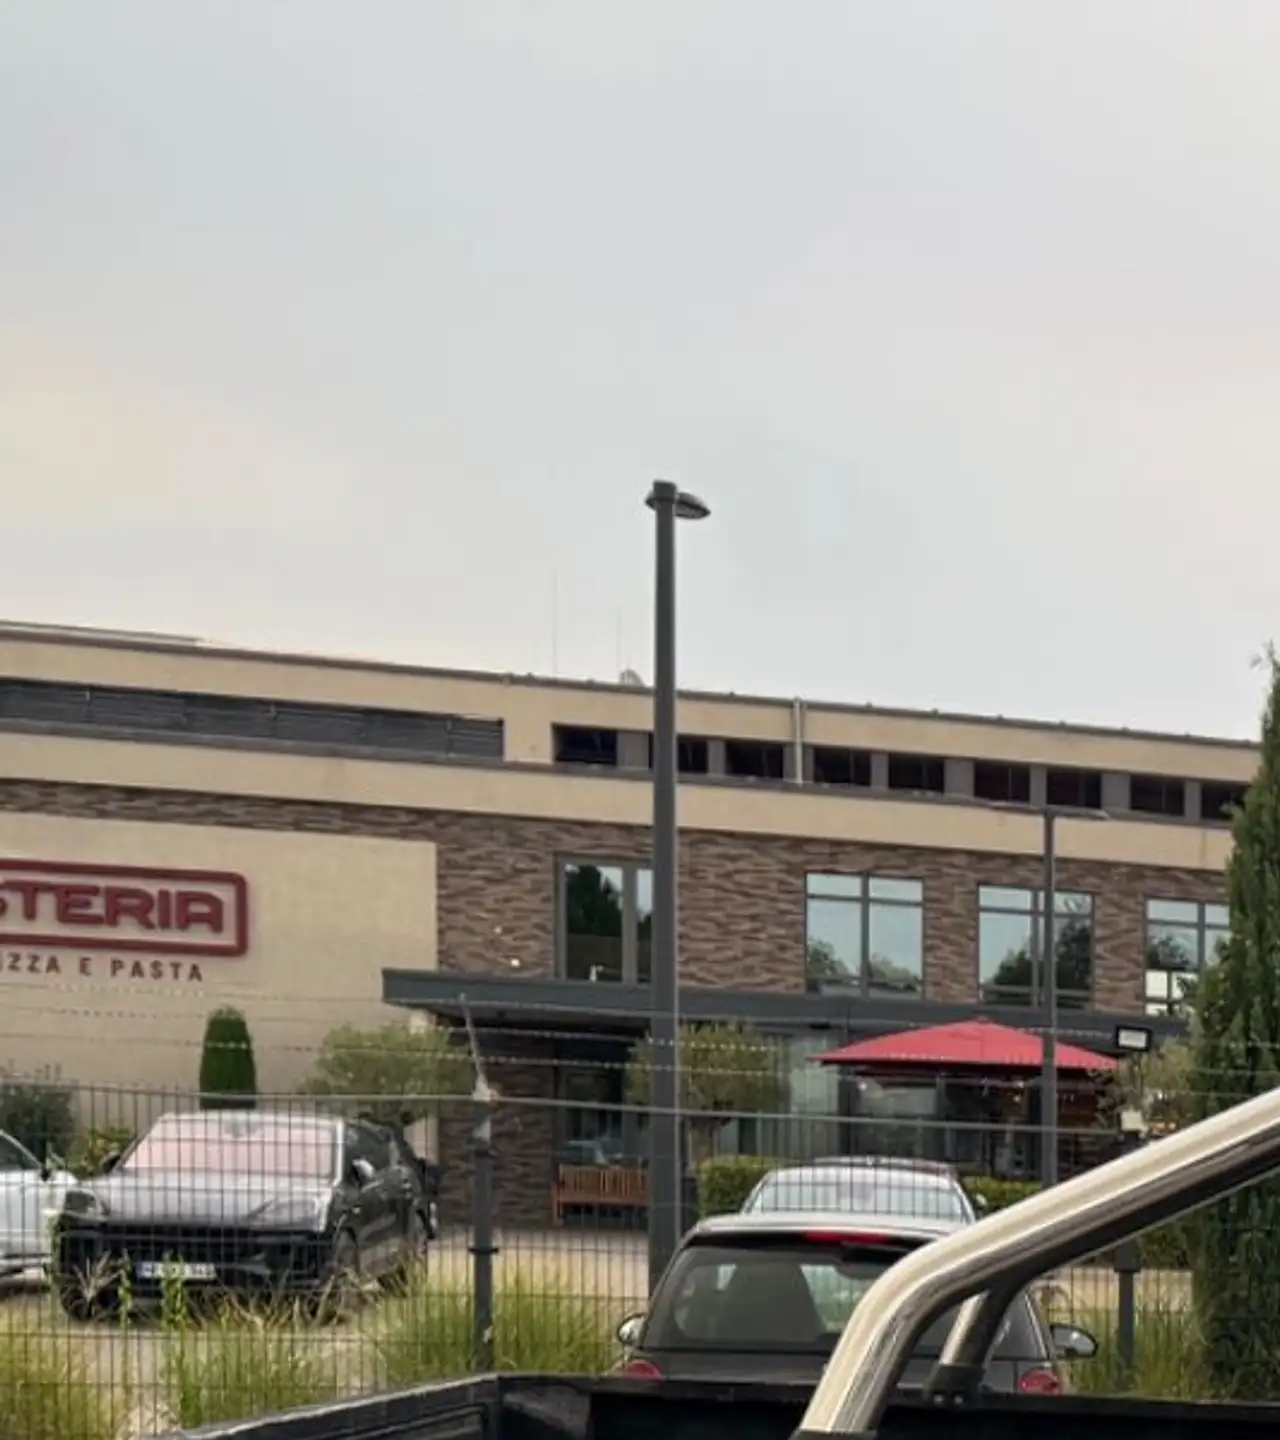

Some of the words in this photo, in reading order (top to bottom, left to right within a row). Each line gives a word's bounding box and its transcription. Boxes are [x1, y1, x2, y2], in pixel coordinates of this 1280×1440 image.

[0, 881, 224, 934] TERIA
[79, 956, 93, 977] E
[110, 957, 203, 983] PASTA
